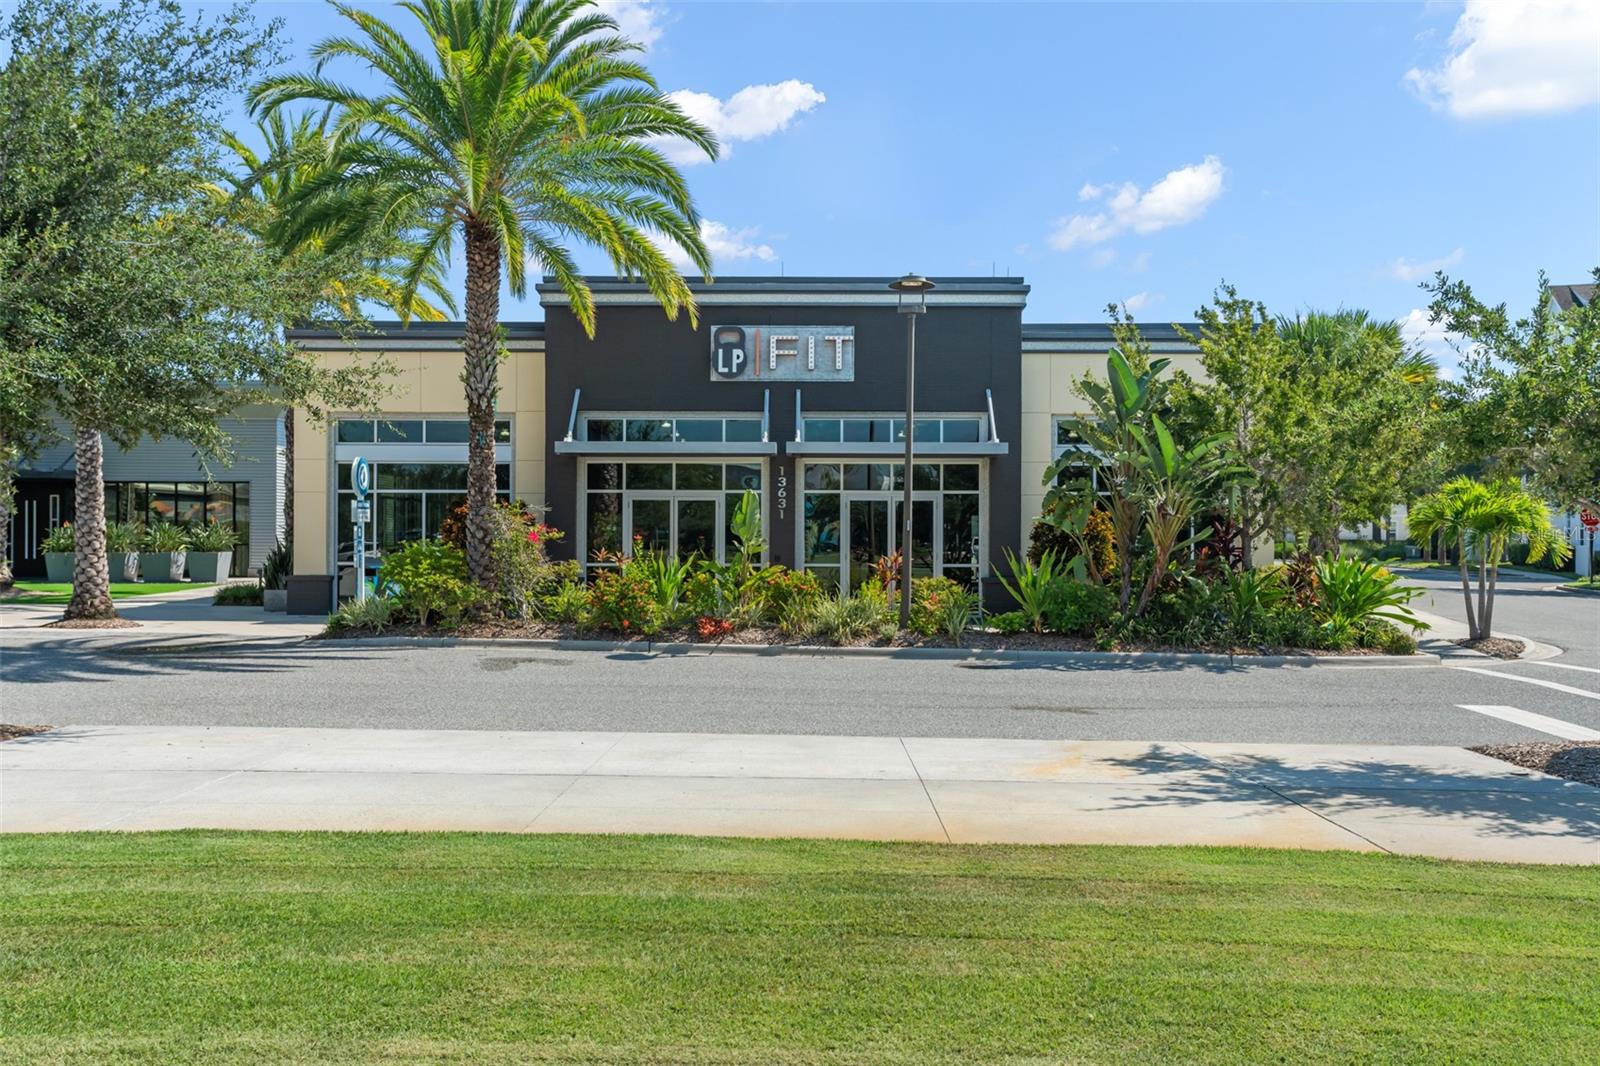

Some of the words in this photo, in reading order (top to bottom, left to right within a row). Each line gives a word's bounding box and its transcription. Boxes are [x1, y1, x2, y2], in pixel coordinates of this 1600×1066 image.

[718, 348, 744, 372] LP
[769, 335, 854, 370] FIT
[777, 466, 787, 519] 13631
[1581, 511, 1600, 521] STO
